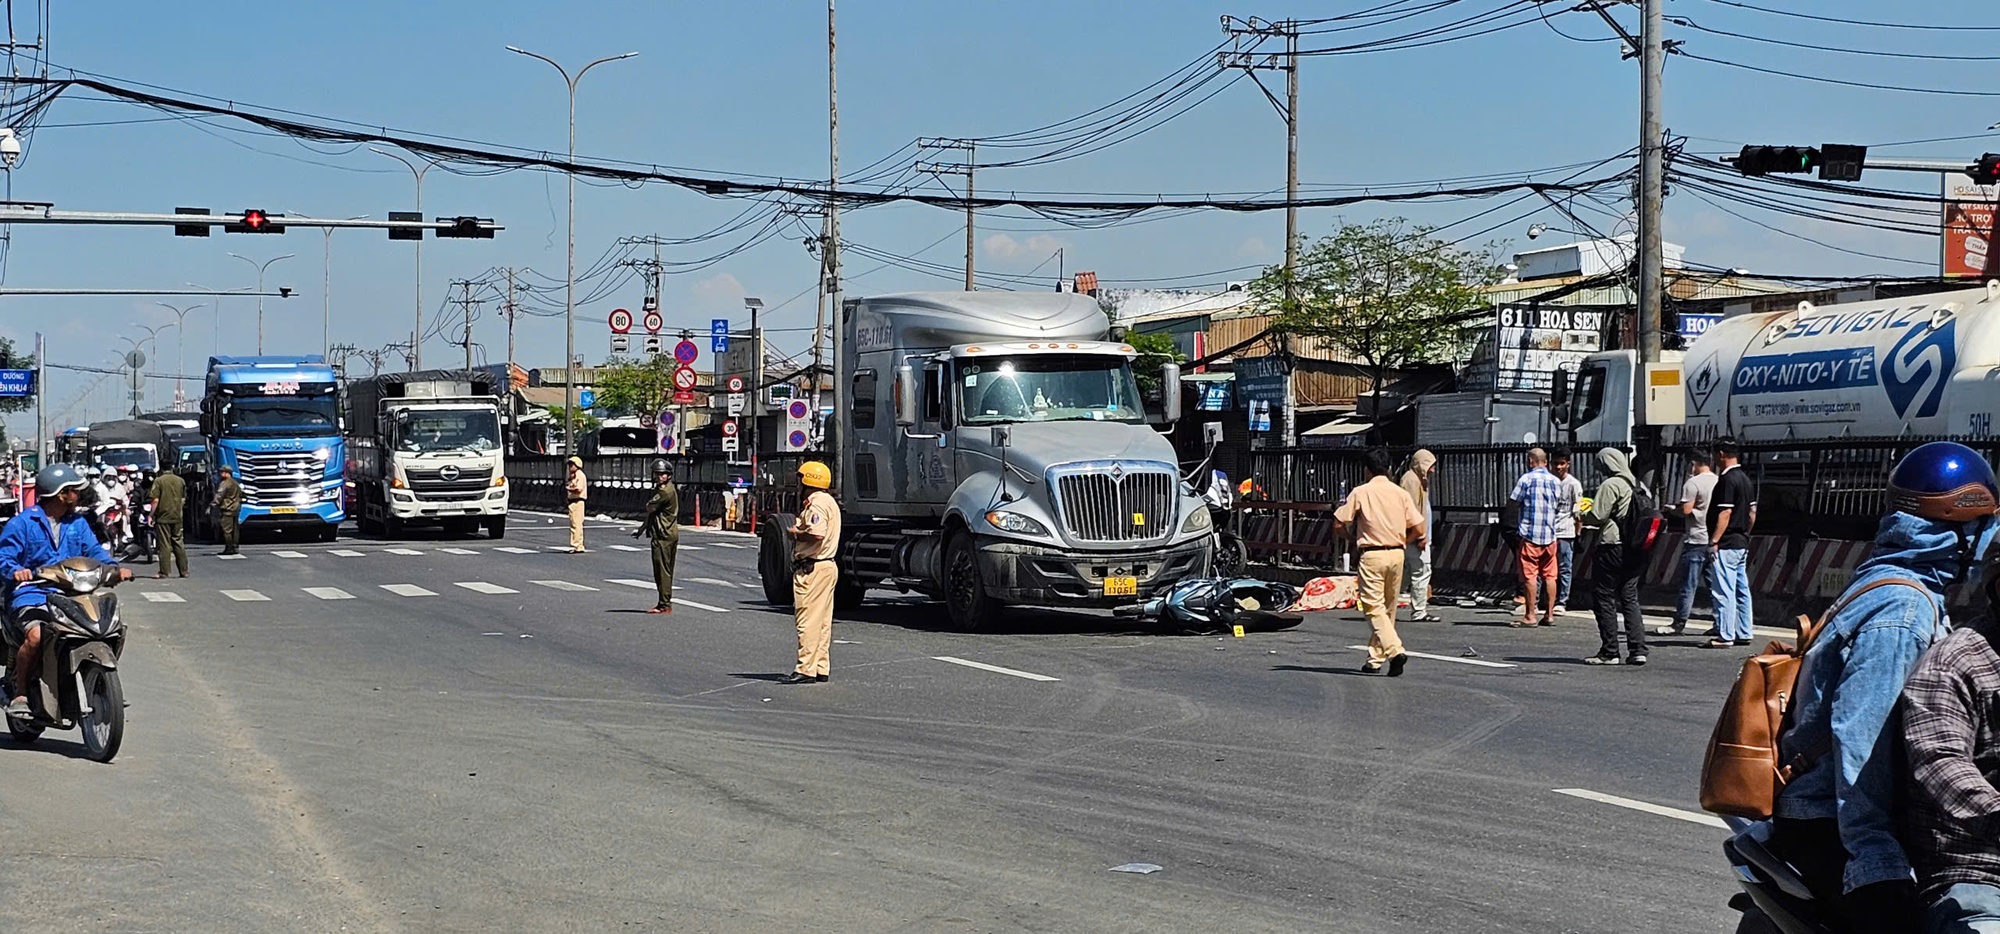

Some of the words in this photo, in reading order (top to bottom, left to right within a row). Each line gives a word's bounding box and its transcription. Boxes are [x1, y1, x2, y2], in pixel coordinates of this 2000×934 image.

[615, 316, 626, 326] 80
[649, 319, 658, 327] 60
[1501, 308, 1535, 327] 611
[1540, 310, 1570, 329] HOA
[1573, 312, 1602, 330] SEN
[1785, 304, 1929, 338] SOVIGAZ
[3, 371, 25, 380] ĐƯỜNG
[732, 380, 740, 388] 50
[1969, 413, 1991, 436] 50H
[1113, 578, 1128, 586] 65C
